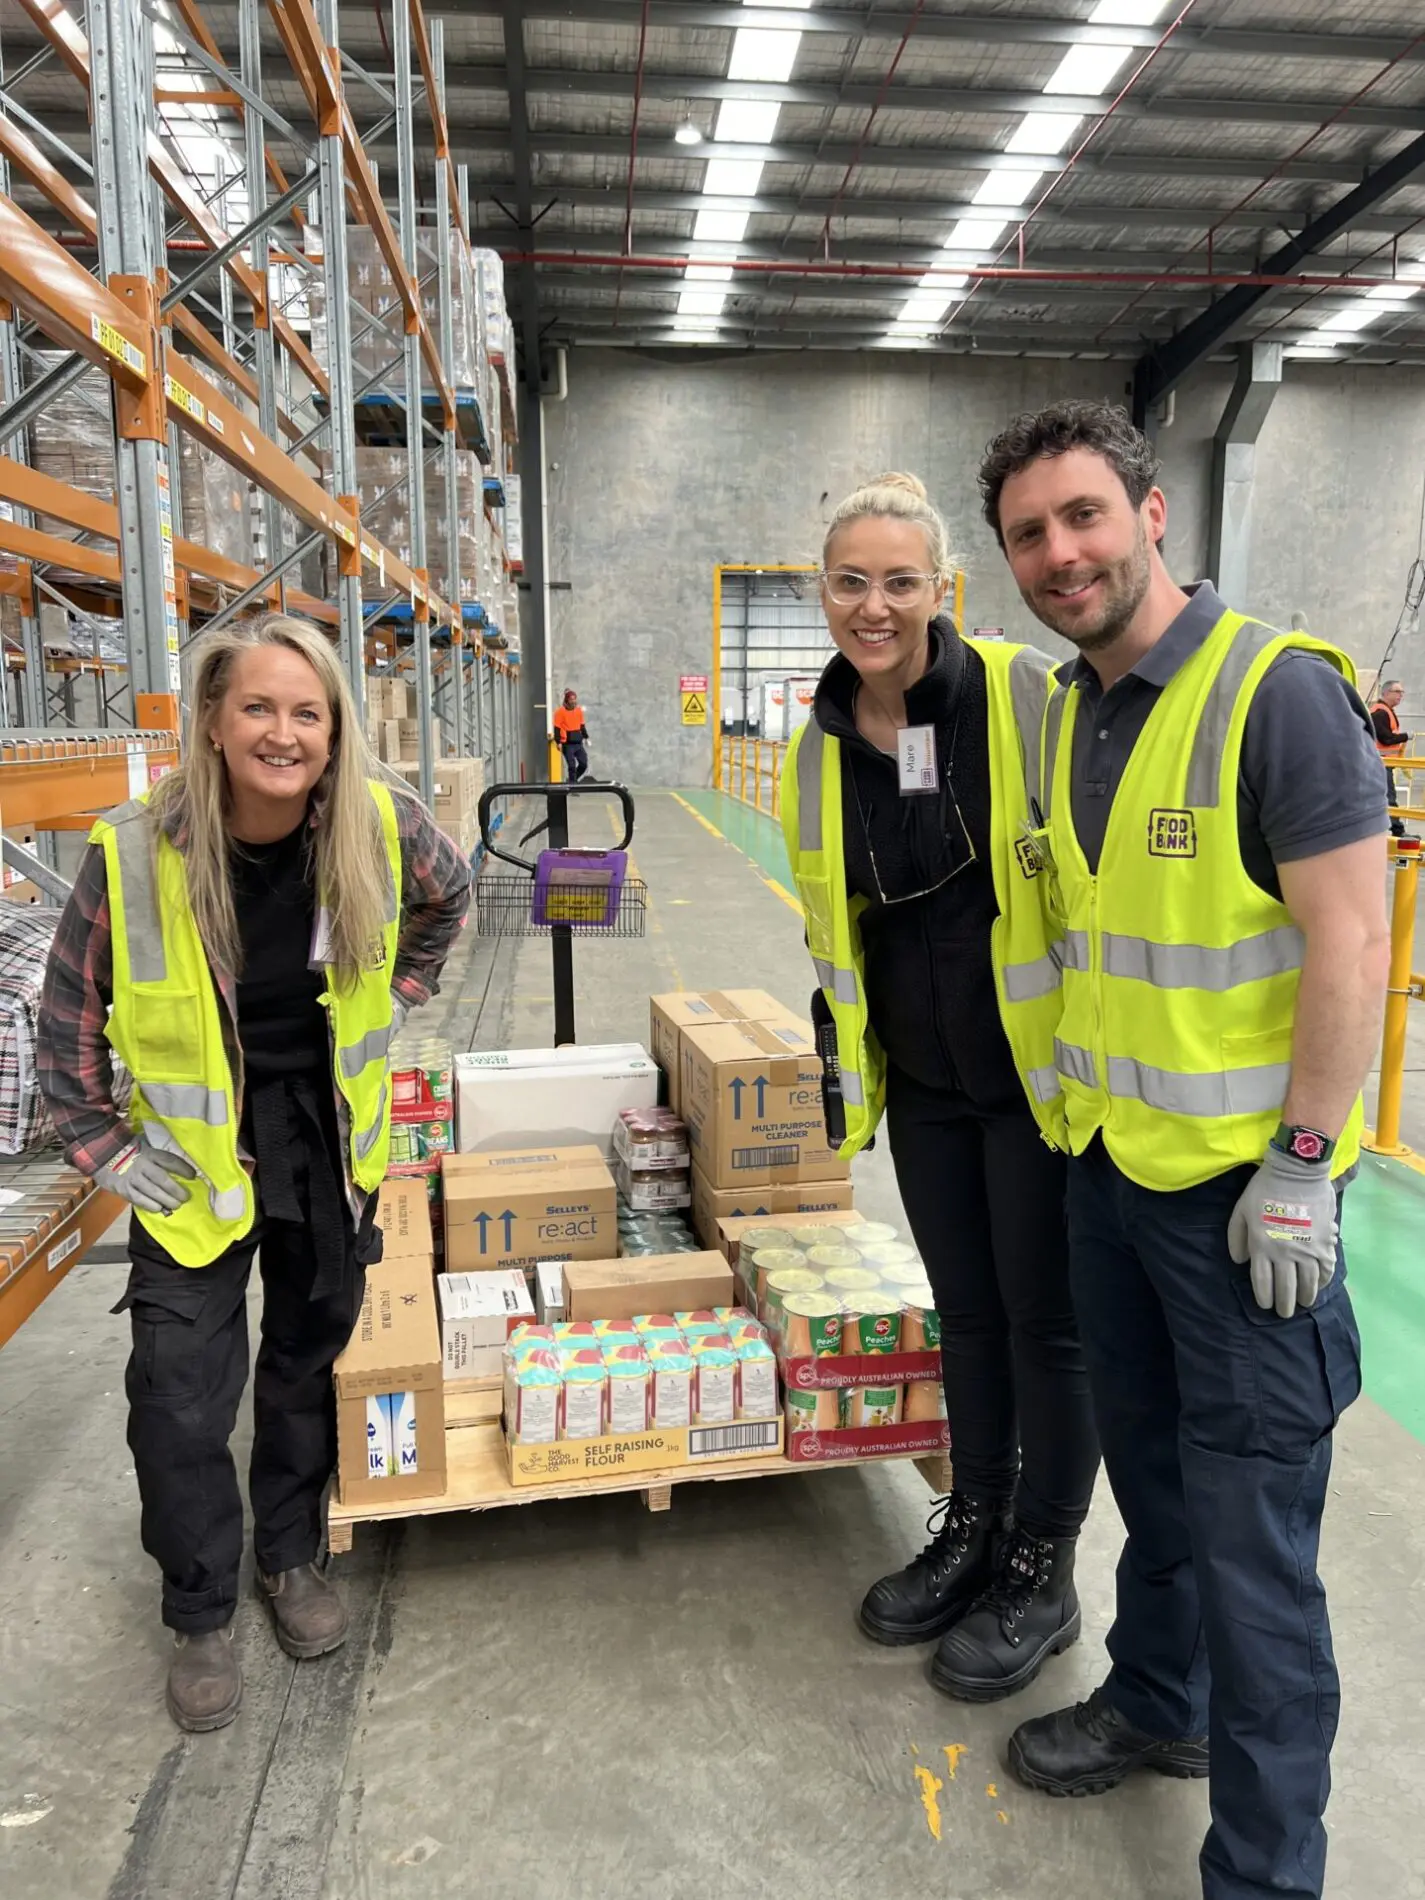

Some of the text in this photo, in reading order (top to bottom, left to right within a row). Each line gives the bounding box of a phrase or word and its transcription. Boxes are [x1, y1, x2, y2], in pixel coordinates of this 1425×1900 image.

[751, 1120, 822, 1133] MULTI PURPOSE
[765, 1130, 808, 1140] CLEANER
[546, 1204, 589, 1215] SELLEYS
[797, 1202, 838, 1213] SELLEYS
[538, 1216, 598, 1239] re:act
[498, 1253, 573, 1268] MULTI PURPOSE
[865, 1334, 896, 1344] Peaches
[820, 1370, 936, 1386] PROUDLY AUSTRALIAN OWNED
[584, 1438, 664, 1456] SELF RAISING
[825, 1438, 938, 1457] PROUDLY AUSTRALIAN OWNED
[548, 1458, 579, 1467] HARVEST
[585, 1453, 625, 1467] FLOUR
